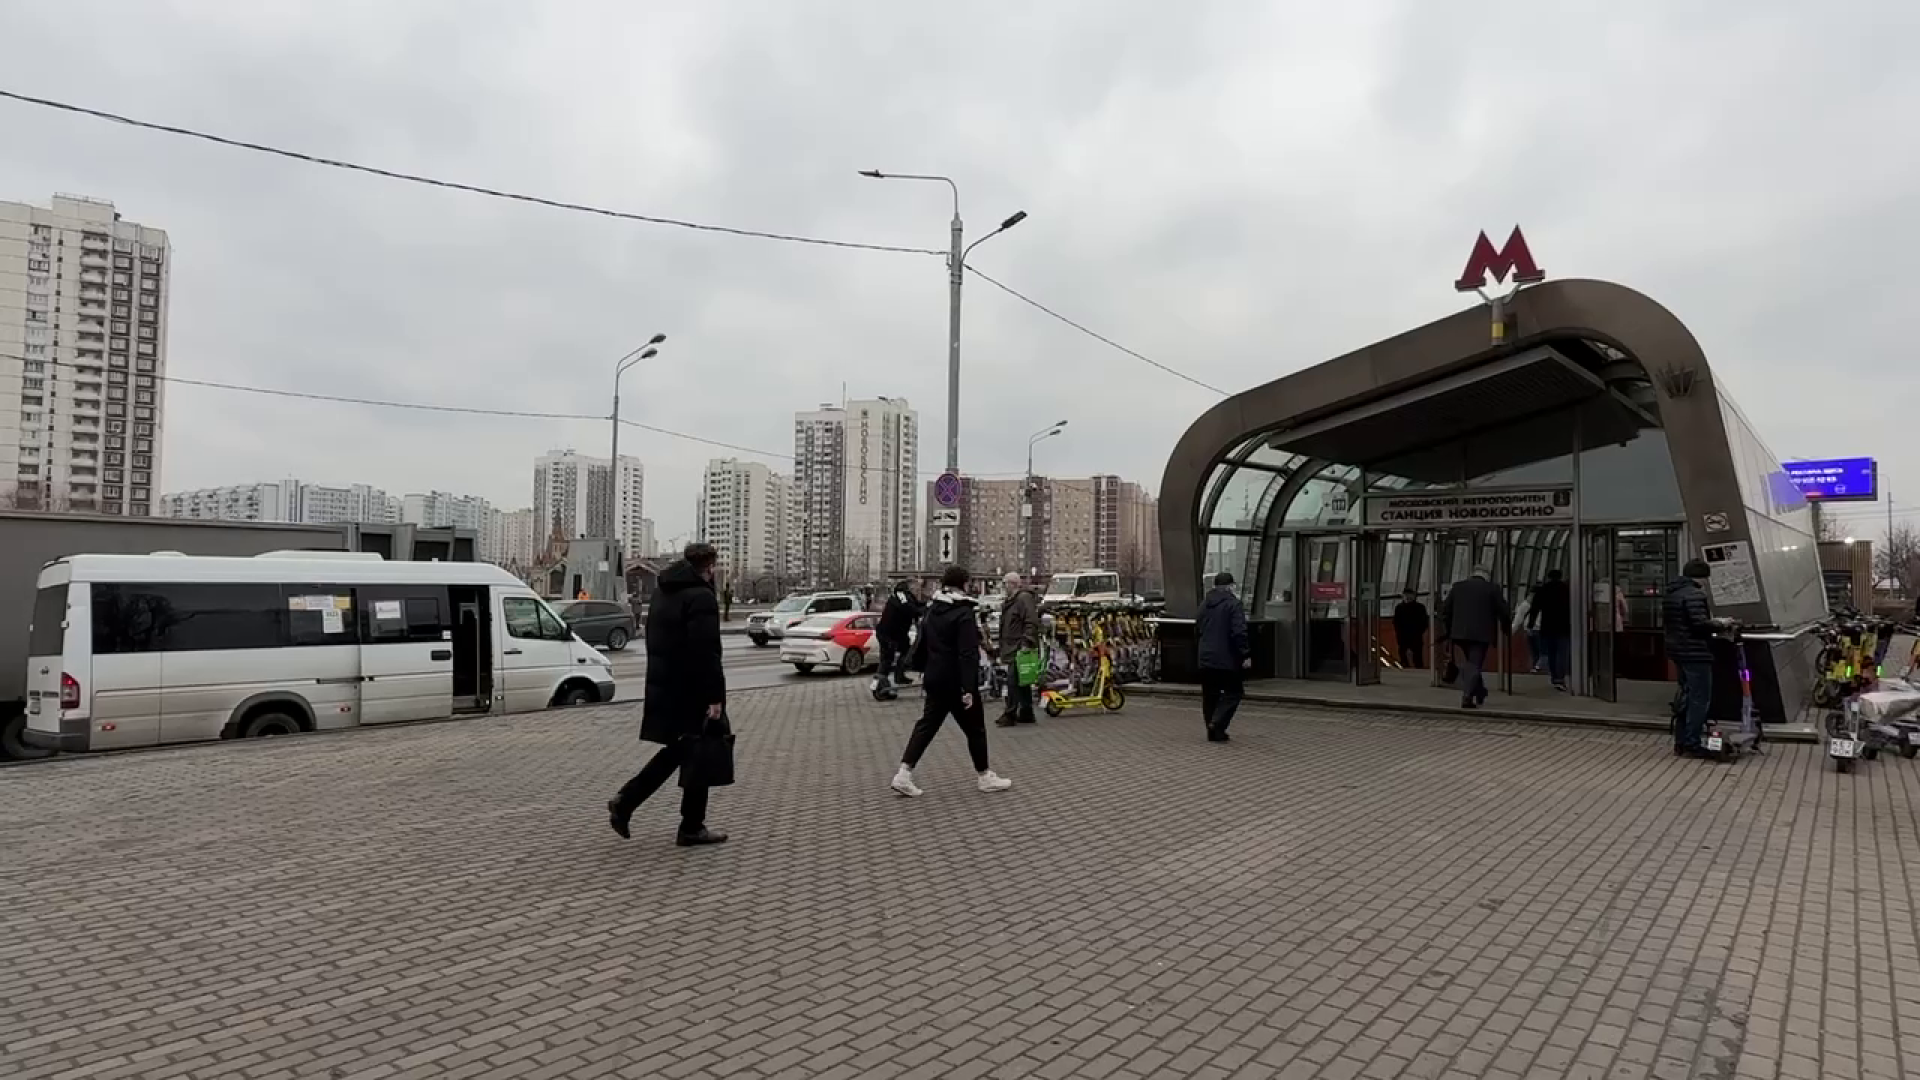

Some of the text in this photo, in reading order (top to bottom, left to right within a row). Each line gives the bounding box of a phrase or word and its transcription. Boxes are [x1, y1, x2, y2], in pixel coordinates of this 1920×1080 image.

[1455, 222, 1545, 292] М
[1388, 494, 1546, 508] МОСКОВСКИЙ МЕТРОПОЛИТЕН
[1380, 505, 1555, 521] СТАНЦИЯ НОВОКОСИНО
